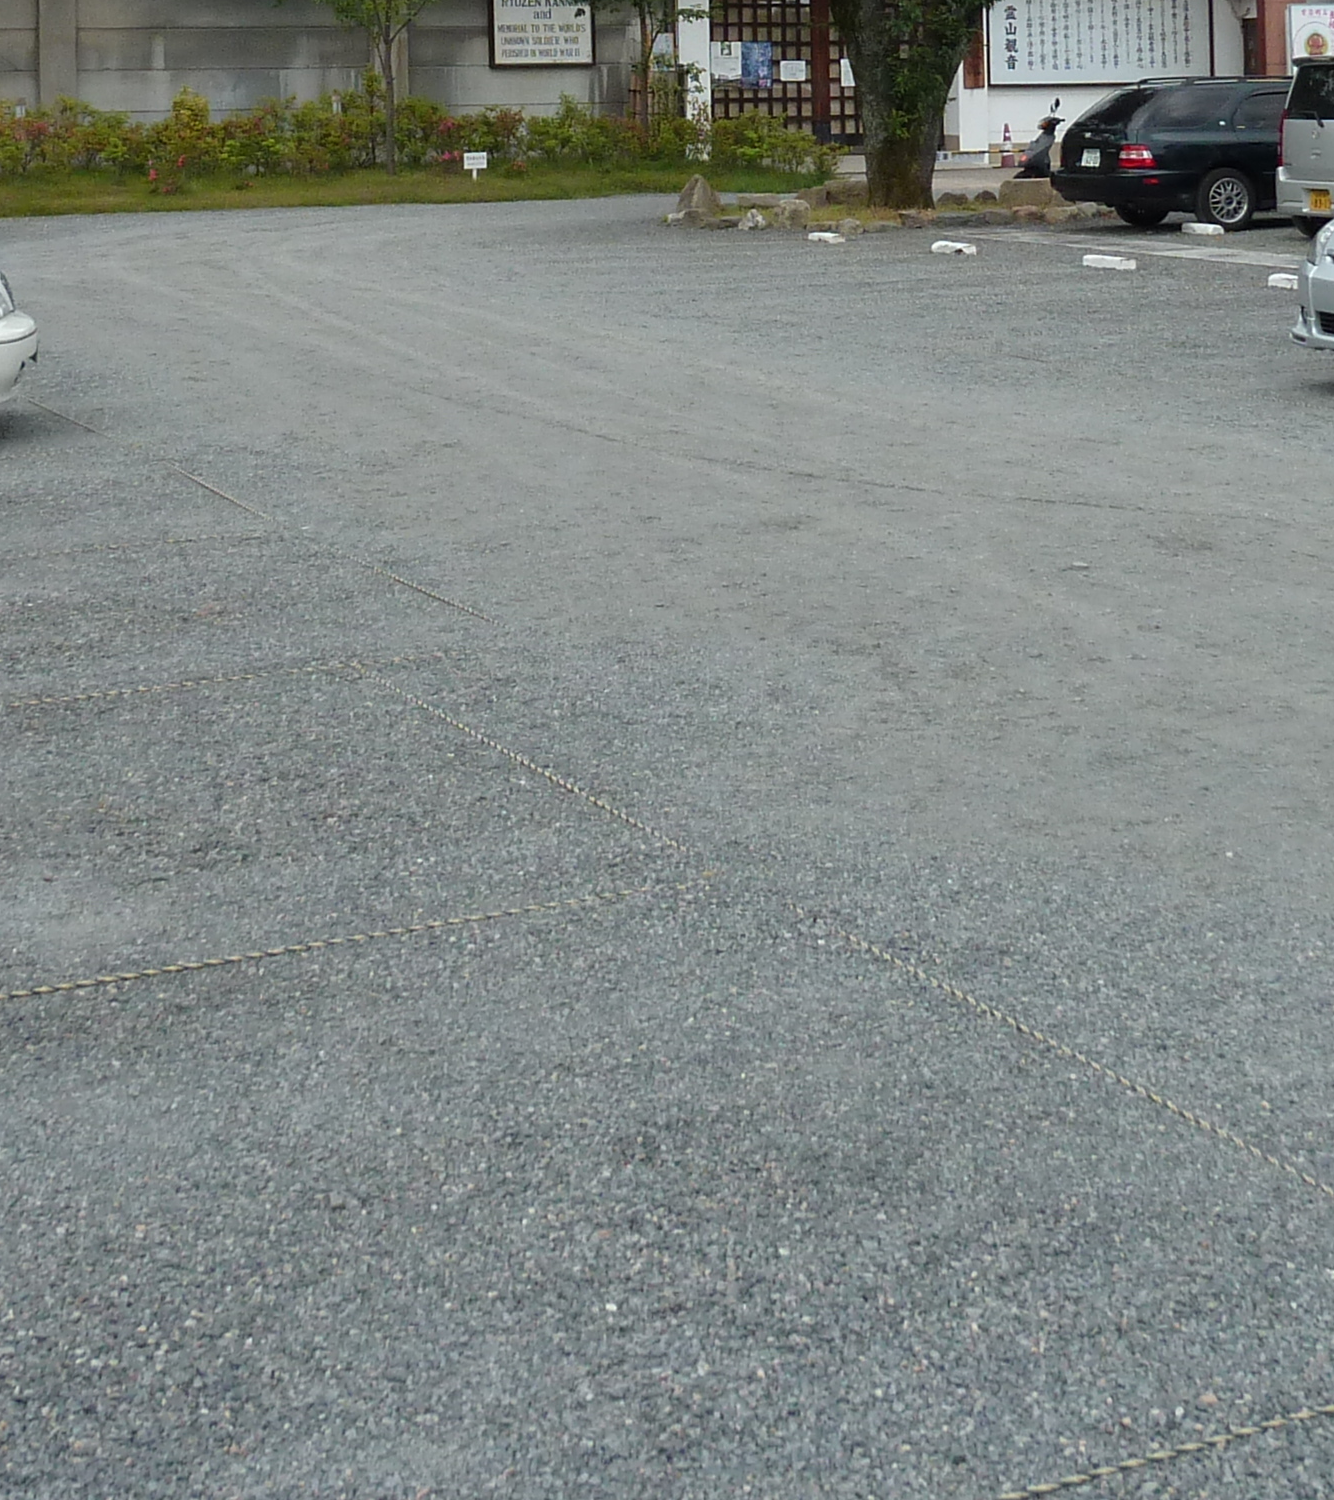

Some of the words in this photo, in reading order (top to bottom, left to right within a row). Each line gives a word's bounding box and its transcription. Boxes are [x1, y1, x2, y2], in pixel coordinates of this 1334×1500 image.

[533, 8, 552, 20] and
[497, 24, 528, 33] MEMORIAL
[531, 24, 540, 33] TO
[543, 24, 556, 33] THE
[501, 36, 529, 45] UNKNOWN
[532, 36, 560, 45] SOLDIER
[563, 36, 579, 45] WHO
[530, 49, 537, 57] IN
[538, 49, 558, 57] WORLD
[559, 49, 573, 57] WAR
